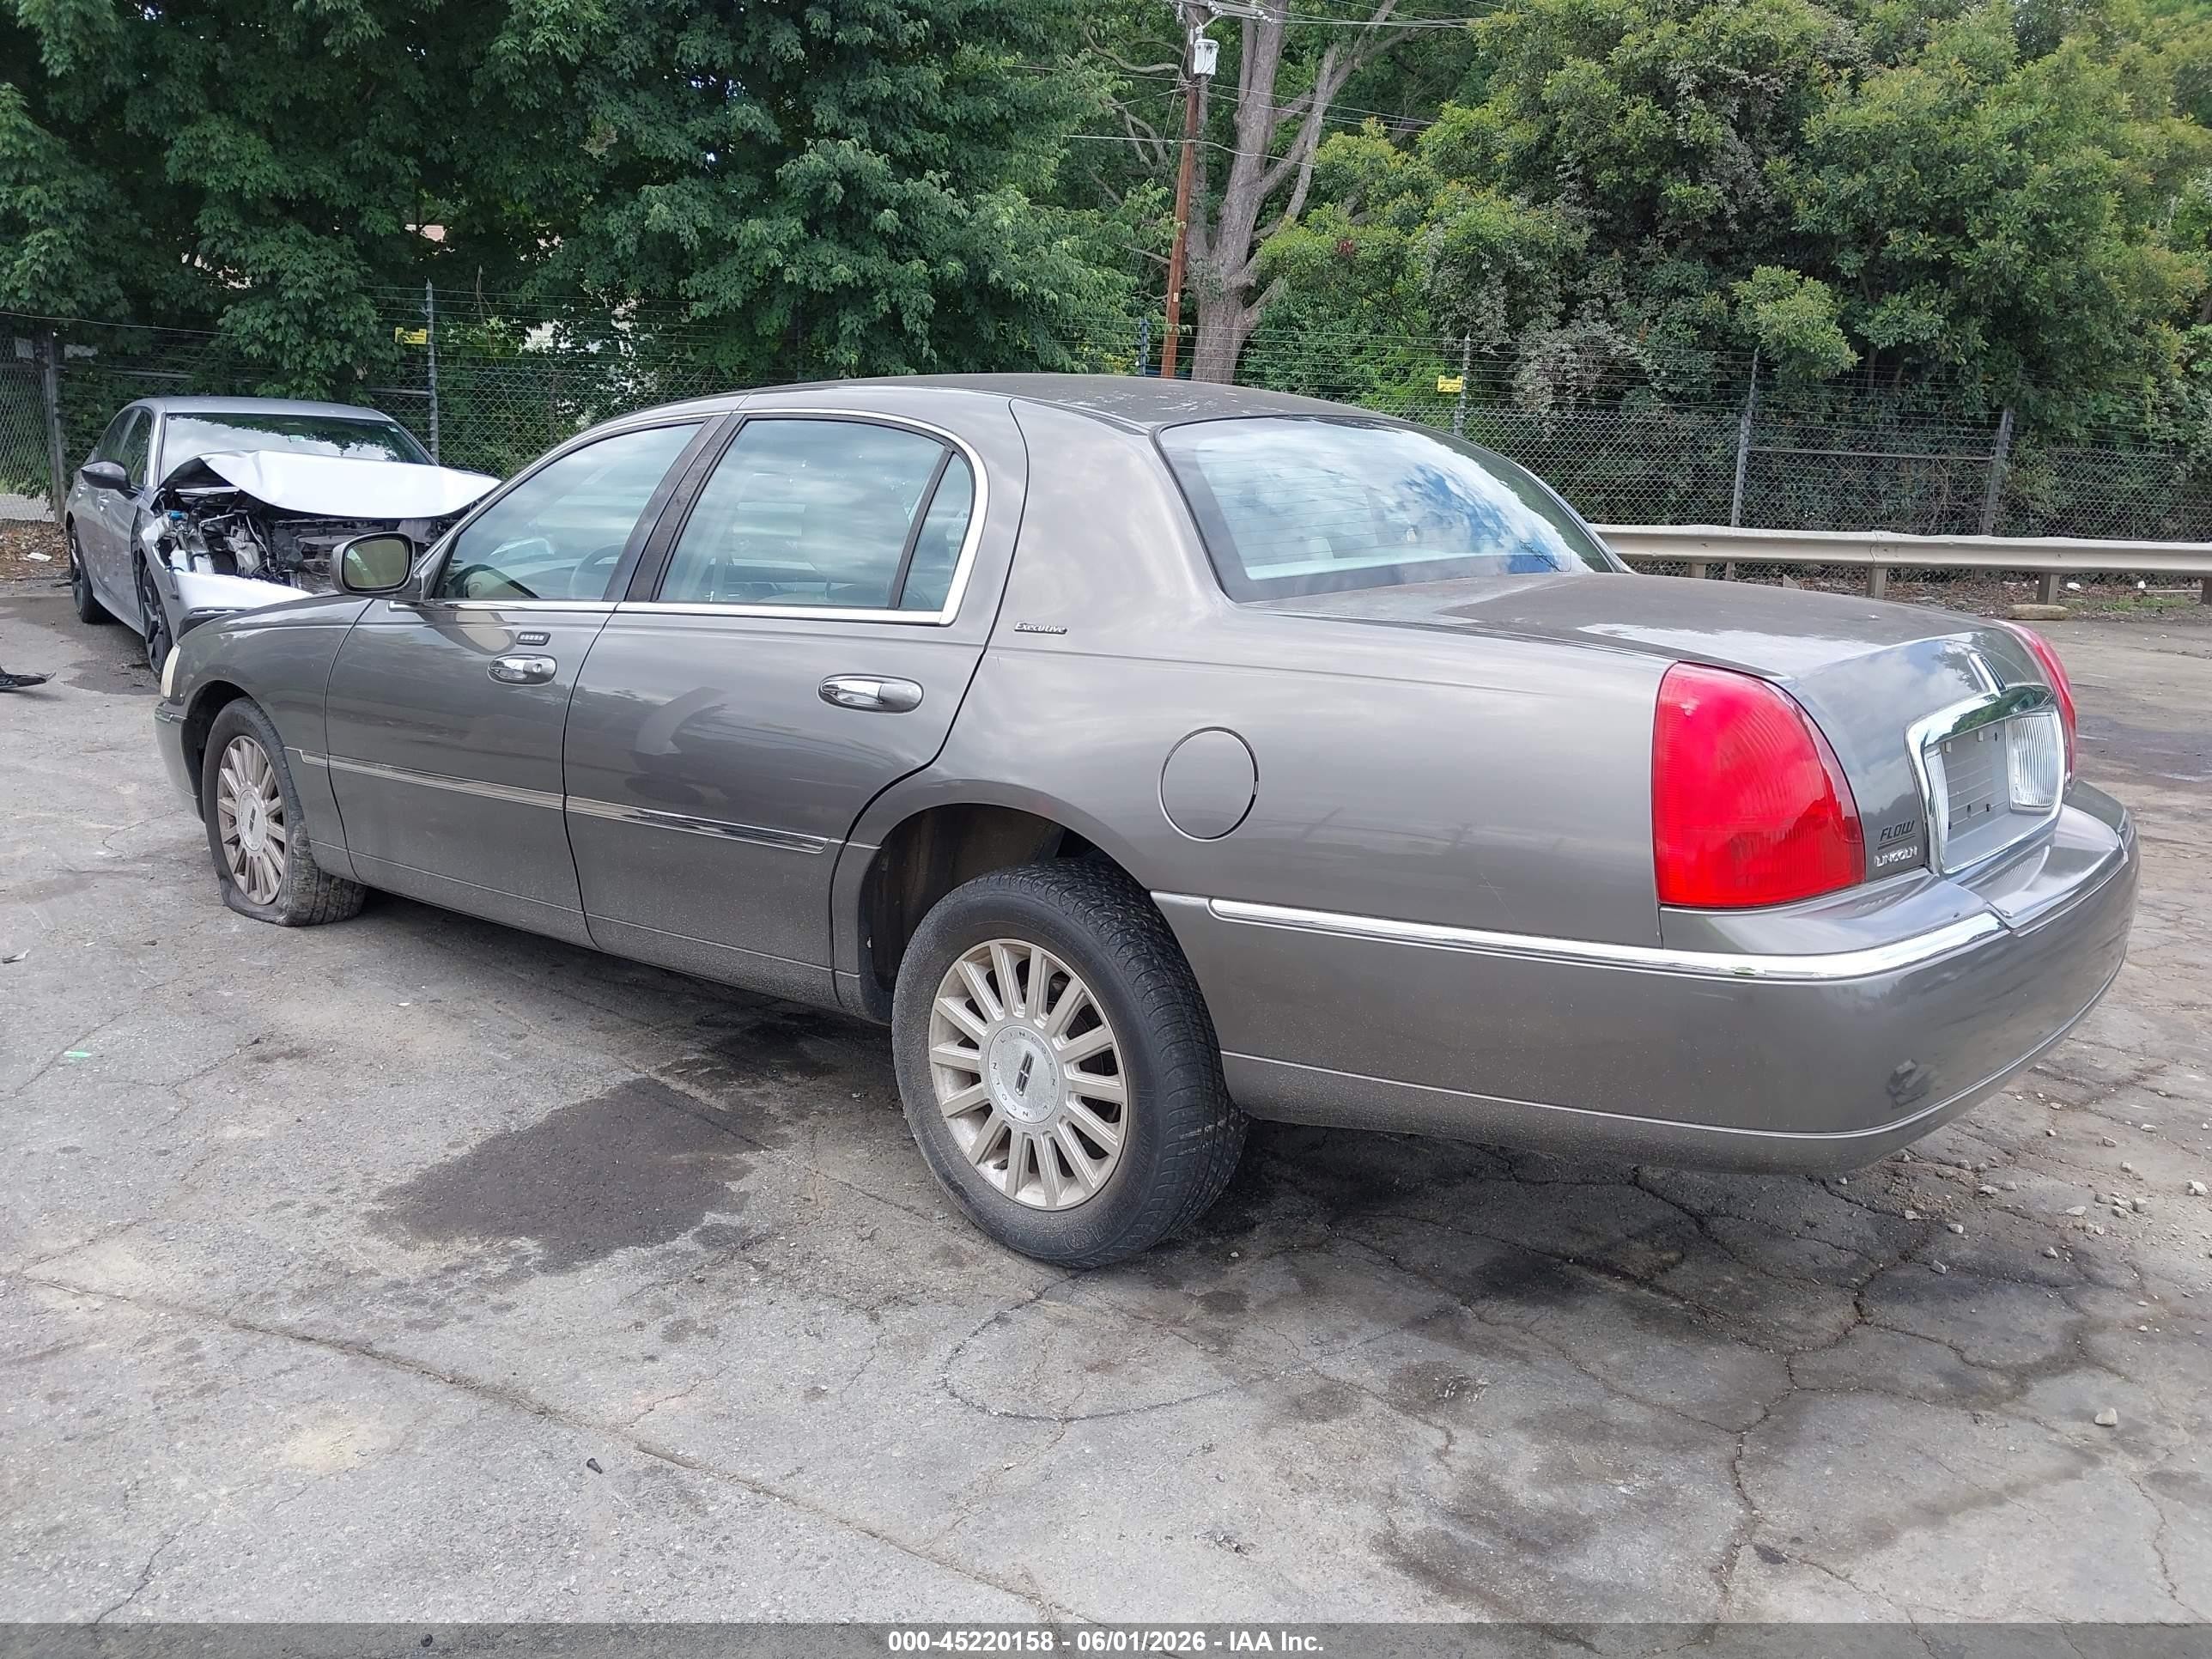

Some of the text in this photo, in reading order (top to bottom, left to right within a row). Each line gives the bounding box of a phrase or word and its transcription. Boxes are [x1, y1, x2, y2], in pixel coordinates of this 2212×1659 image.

[1015, 622, 1066, 633] Executive
[1880, 820, 1915, 842] FLOW
[1875, 845, 1918, 867] LINCOLN
